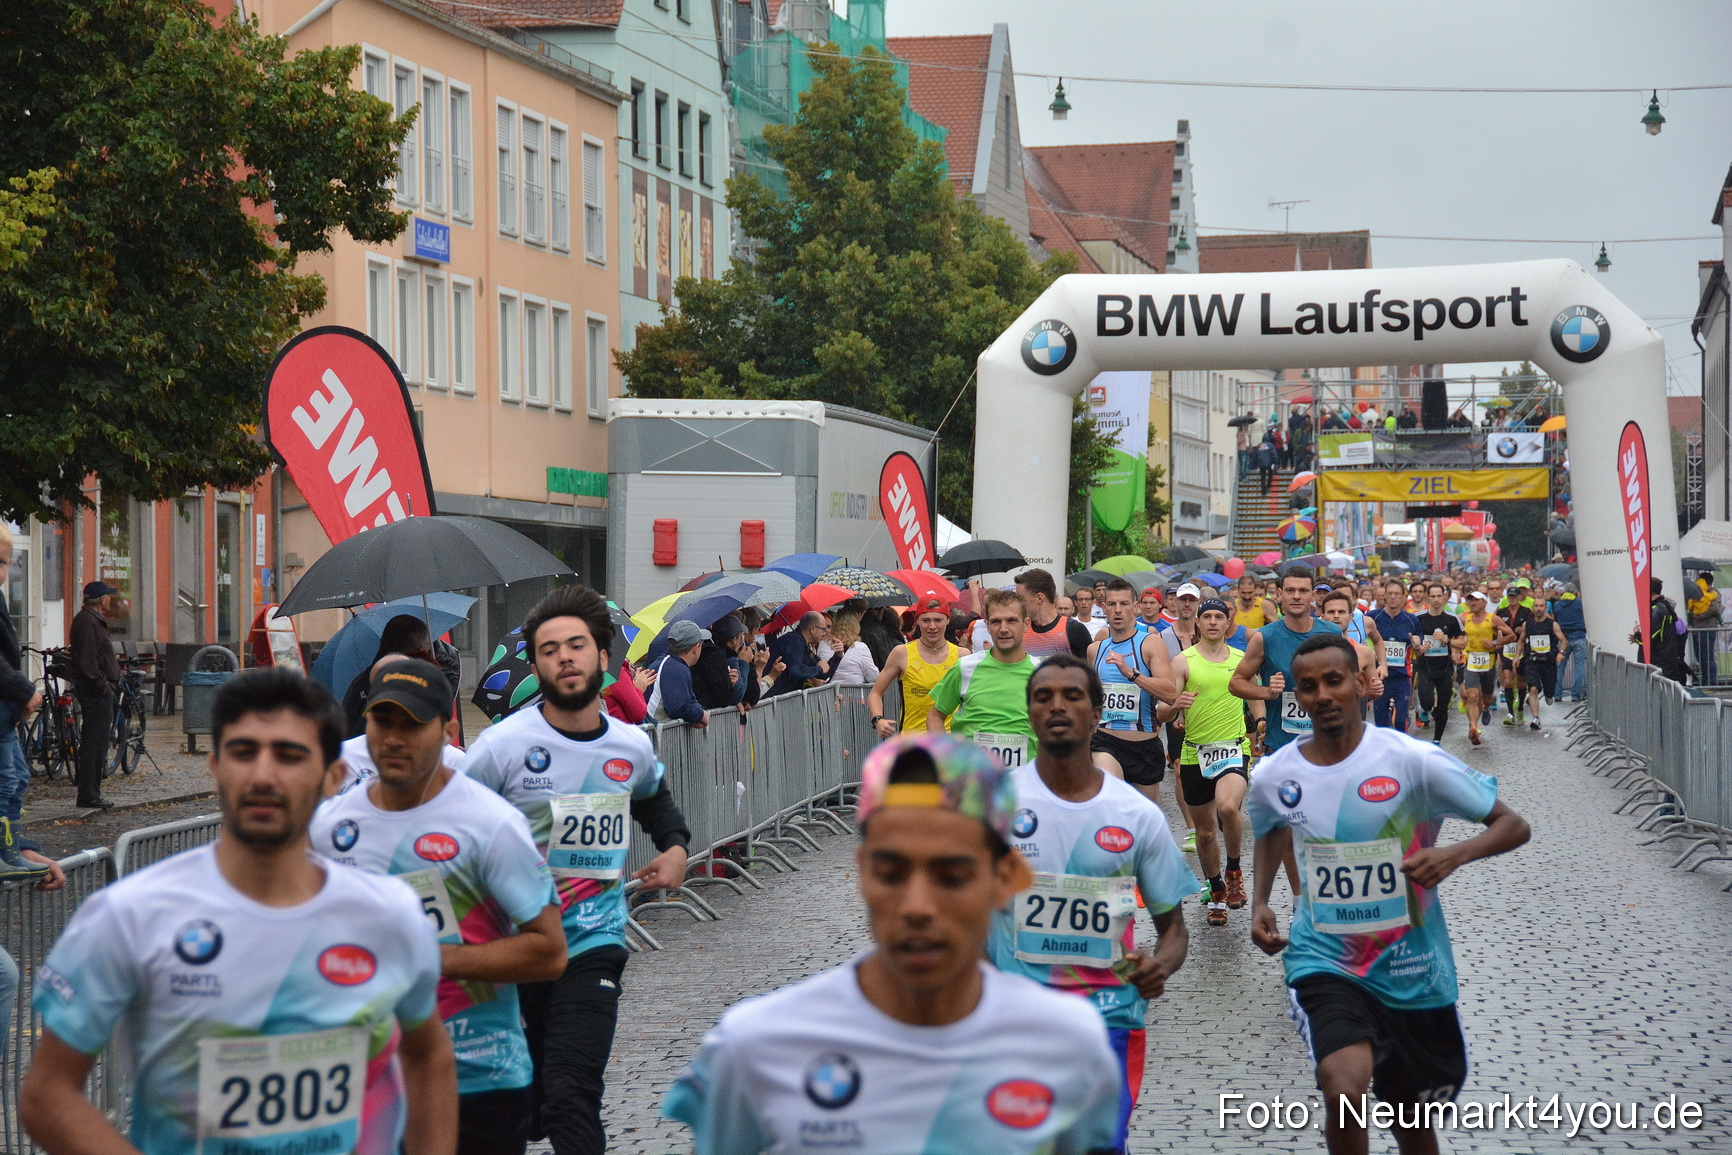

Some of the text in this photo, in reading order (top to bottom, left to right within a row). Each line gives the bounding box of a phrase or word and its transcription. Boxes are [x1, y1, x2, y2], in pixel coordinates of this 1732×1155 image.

[1096, 286, 1529, 341] BMW Laufsport
[1556, 306, 1607, 326] BMW
[1025, 320, 1072, 341] BMW
[1409, 477, 1470, 494] ZIEL
[1622, 440, 1648, 579] REWE
[1472, 656, 1485, 665] 319
[1107, 712, 1124, 720] Marco
[1203, 748, 1238, 768] 2002
[522, 777, 553, 785] PARTL
[1363, 781, 1396, 797] Hervis
[590, 796, 625, 808] BOCK
[559, 813, 624, 846] 2680
[1343, 842, 1392, 858] BOCK
[569, 853, 613, 867] Baschar
[1063, 877, 1109, 892] BOCK
[1316, 862, 1397, 899] 2679
[577, 901, 599, 914] 17.
[1025, 894, 1110, 934] 2766
[1336, 905, 1380, 921] Mohad
[1041, 938, 1088, 953] Ahmad
[1391, 941, 1412, 957] 17.
[1096, 991, 1121, 1006] 17.
[219, 1063, 351, 1129] 2803
